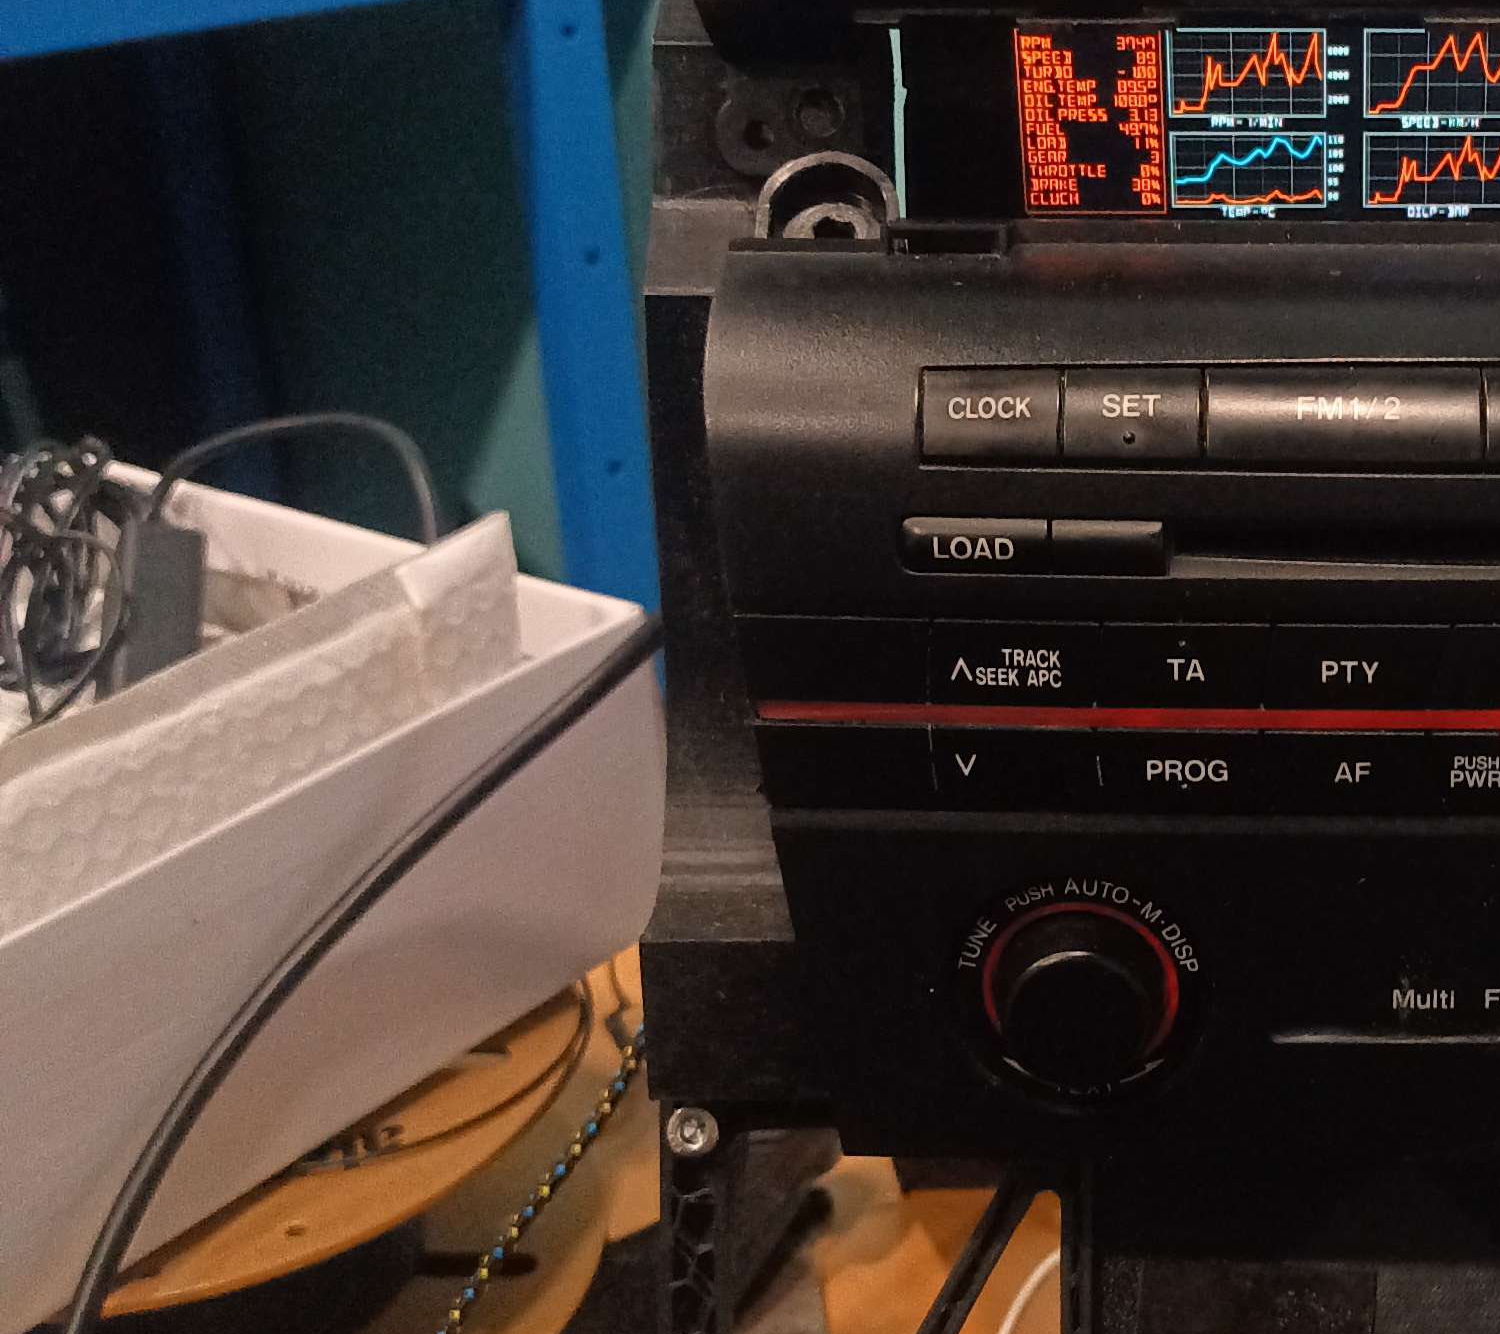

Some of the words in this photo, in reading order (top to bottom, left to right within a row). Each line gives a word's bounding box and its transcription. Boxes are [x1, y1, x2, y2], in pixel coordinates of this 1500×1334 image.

[1020, 35, 1052, 50] RPM
[1021, 50, 1073, 65] SPEED
[1023, 65, 1074, 79] TURBO
[1058, 79, 1097, 94] TEMP
[1024, 94, 1055, 108] OIL
[1058, 94, 1097, 108] TEMP
[1025, 108, 1055, 122] OIL
[1057, 108, 1108, 122] PRESS
[1026, 122, 1065, 136] FUEL
[1026, 136, 1068, 150] LOAD
[1027, 150, 1068, 165] GEAR
[1029, 164, 1108, 178] THROTTLE
[1030, 178, 1079, 192] BRAKE
[1030, 192, 1080, 206] CLUCH
[947, 394, 1032, 420] CLOCK
[1101, 393, 1162, 419] SET
[932, 534, 1015, 562] LOAD
[1001, 648, 1062, 668] TRACK
[975, 667, 1020, 687] SEEK
[1026, 669, 1063, 689] APC
[1166, 658, 1206, 682] TA
[1320, 660, 1380, 685] PTY
[1453, 755, 1500, 771] PUSH
[1145, 759, 1229, 784] PROG
[1333, 761, 1372, 784] AF
[1004, 883, 1056, 913] PUSH
[957, 916, 998, 970] TUNE
[1392, 988, 1456, 1011] Multi
